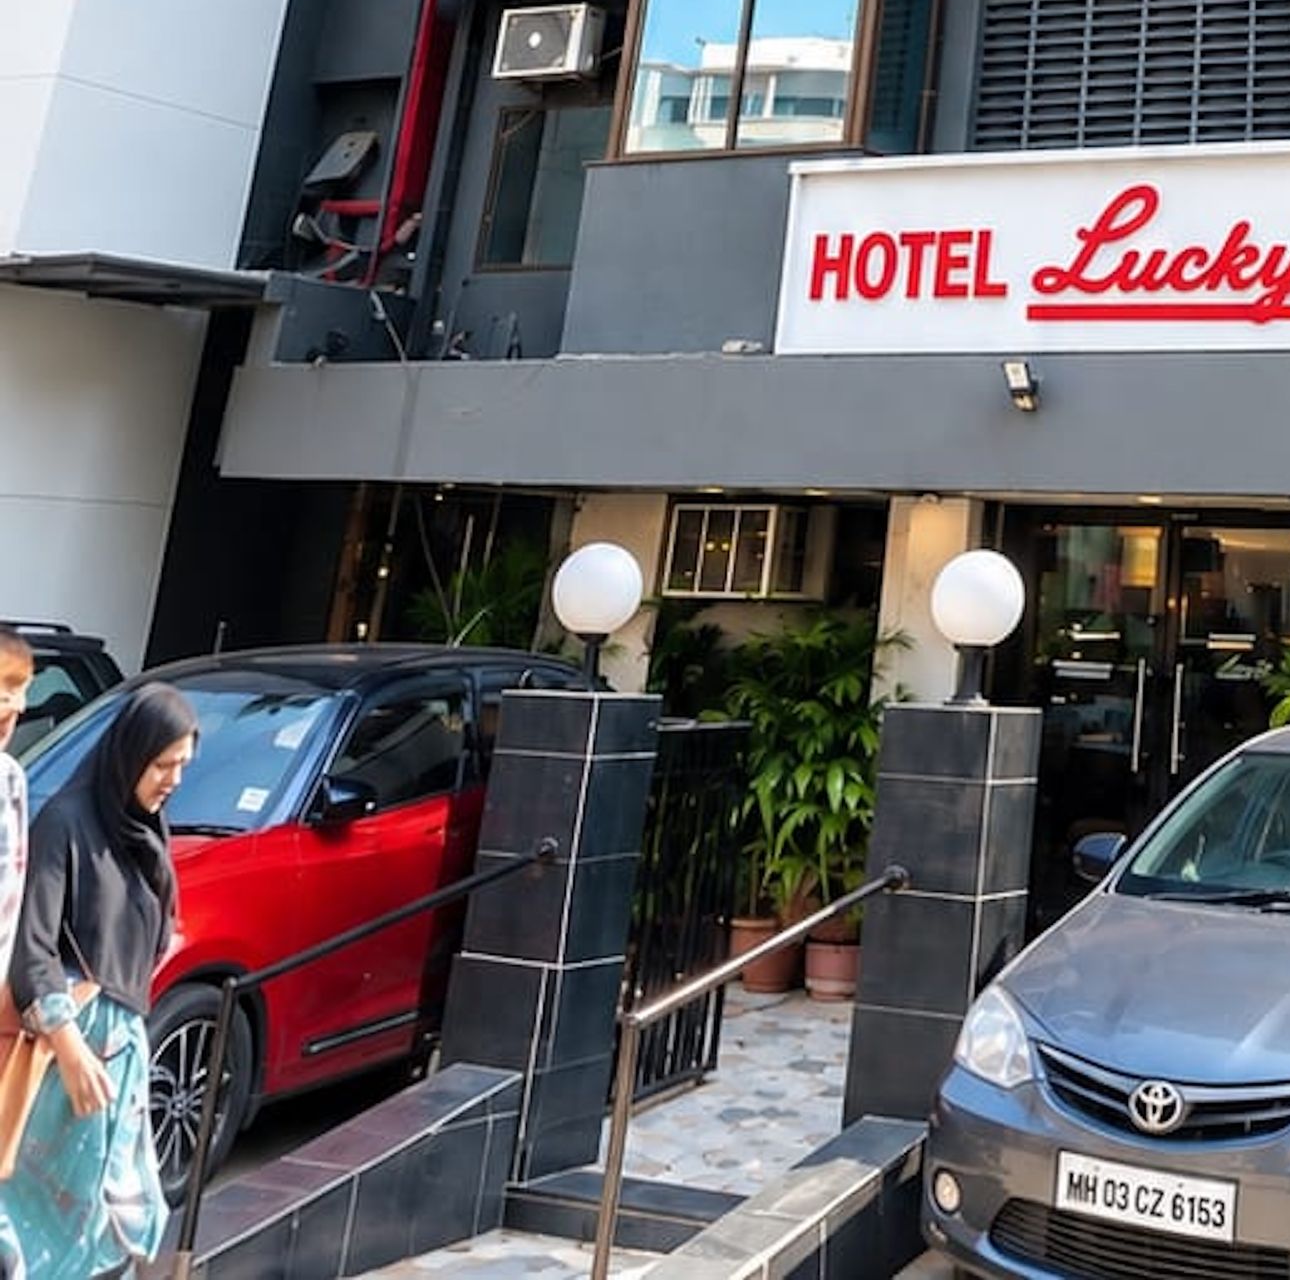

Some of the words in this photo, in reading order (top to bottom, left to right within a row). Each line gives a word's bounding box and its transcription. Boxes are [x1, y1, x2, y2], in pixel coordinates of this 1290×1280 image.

[810, 229, 1008, 301] HOTEL
[1066, 1171, 1098, 1205] MH
[1103, 1179, 1130, 1211] 03
[1135, 1185, 1165, 1218] CZ
[1171, 1193, 1226, 1228] 6153
